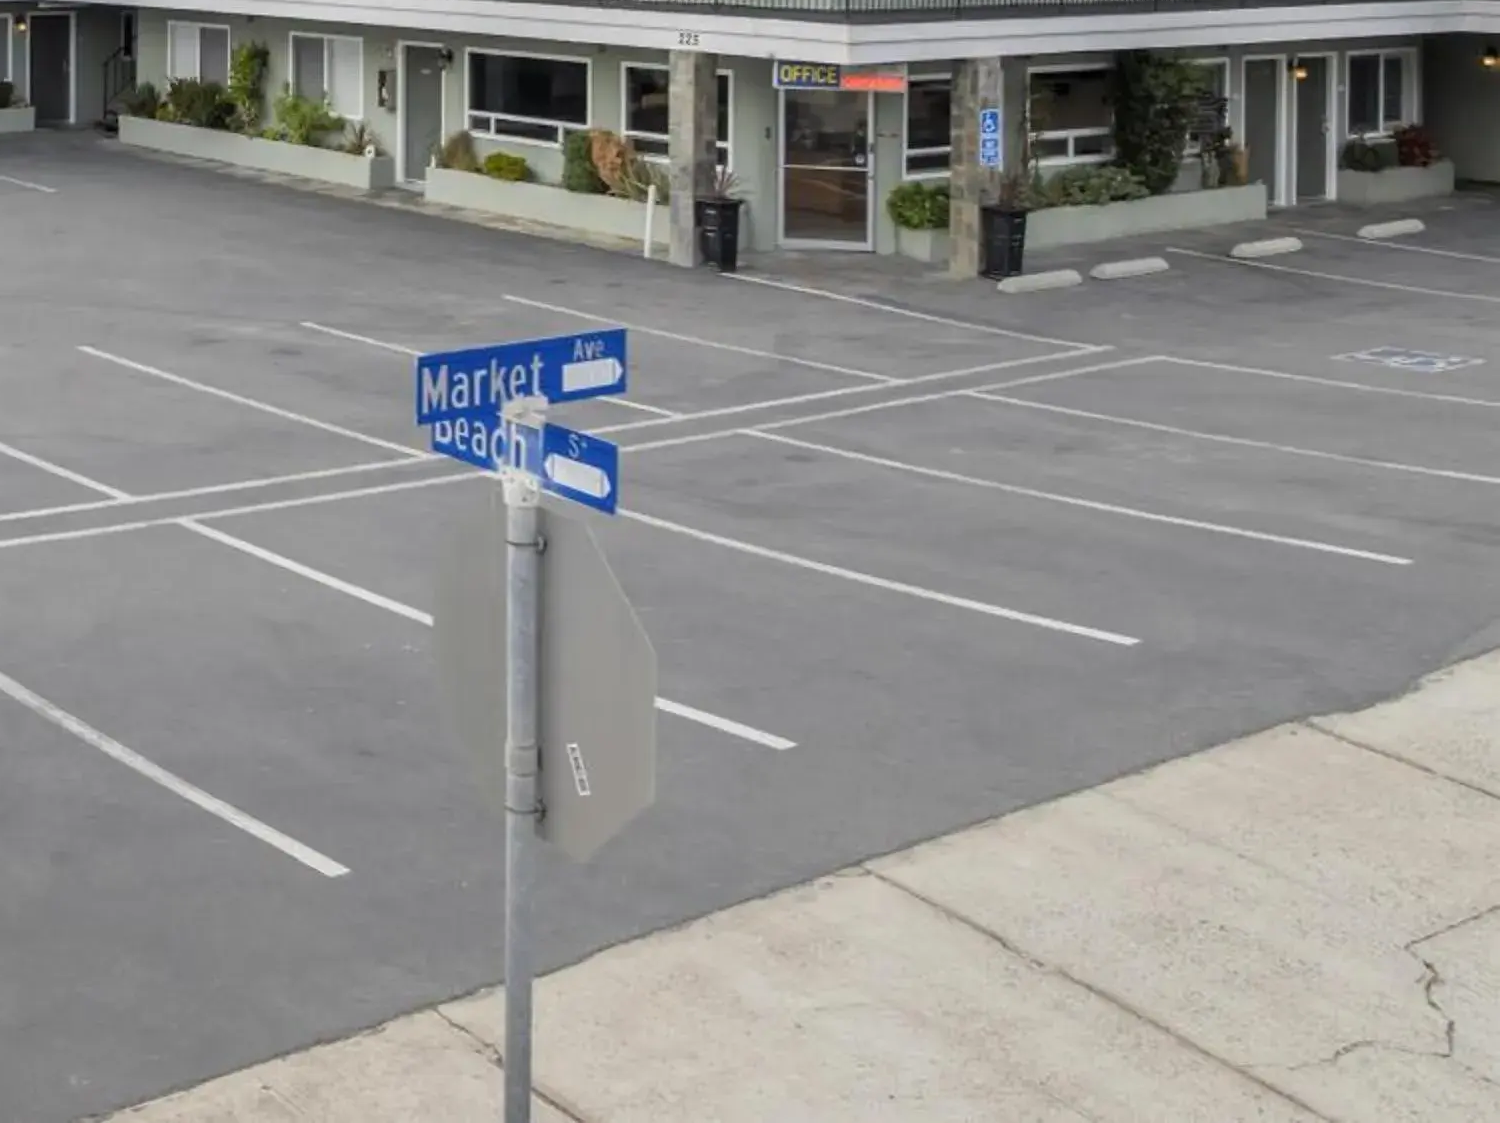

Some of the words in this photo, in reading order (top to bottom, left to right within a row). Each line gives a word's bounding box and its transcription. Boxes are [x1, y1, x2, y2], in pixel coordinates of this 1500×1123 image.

[781, 64, 838, 84] OFFICE
[421, 353, 544, 414] Market
[573, 338, 605, 361] Ave
